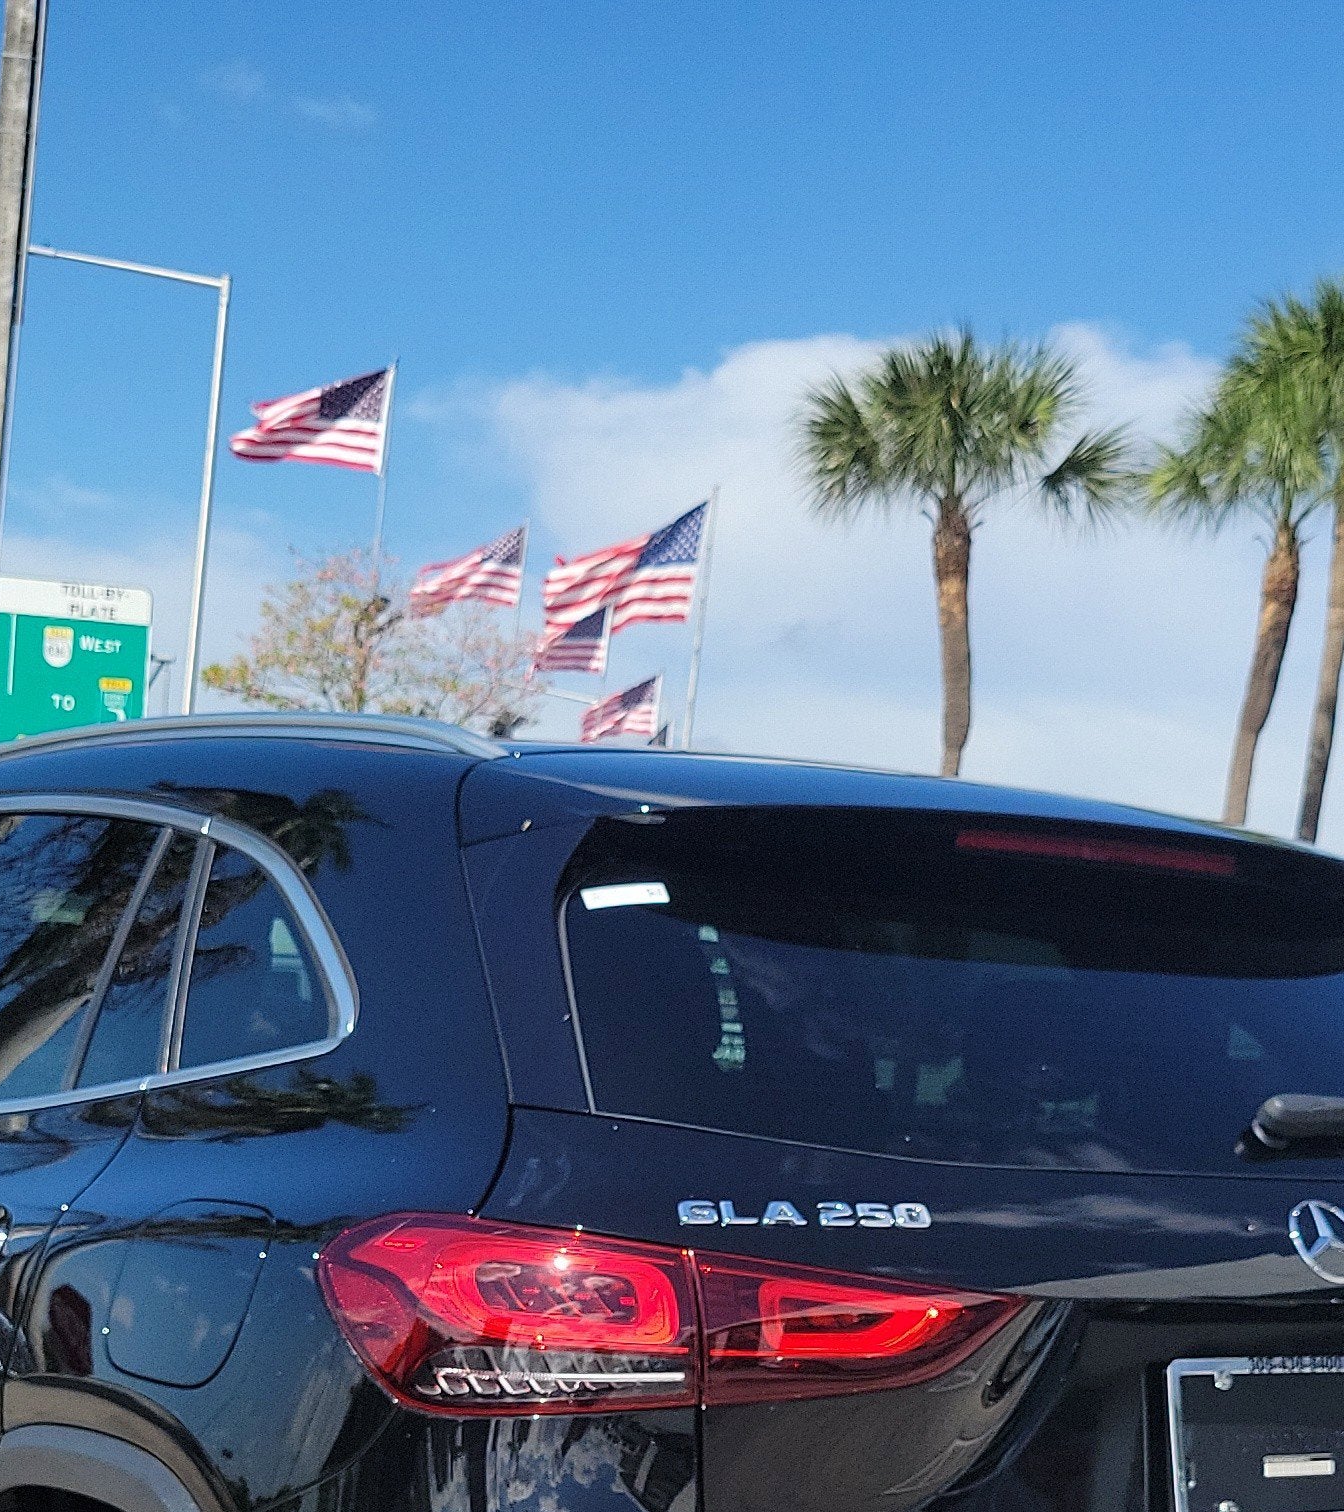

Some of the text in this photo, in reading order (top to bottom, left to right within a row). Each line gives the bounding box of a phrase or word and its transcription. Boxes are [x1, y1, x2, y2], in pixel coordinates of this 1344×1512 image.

[69, 602, 118, 621] PLATE
[78, 634, 122, 654] WEST
[51, 693, 75, 712] TO
[677, 1200, 932, 1229] GLA 250
